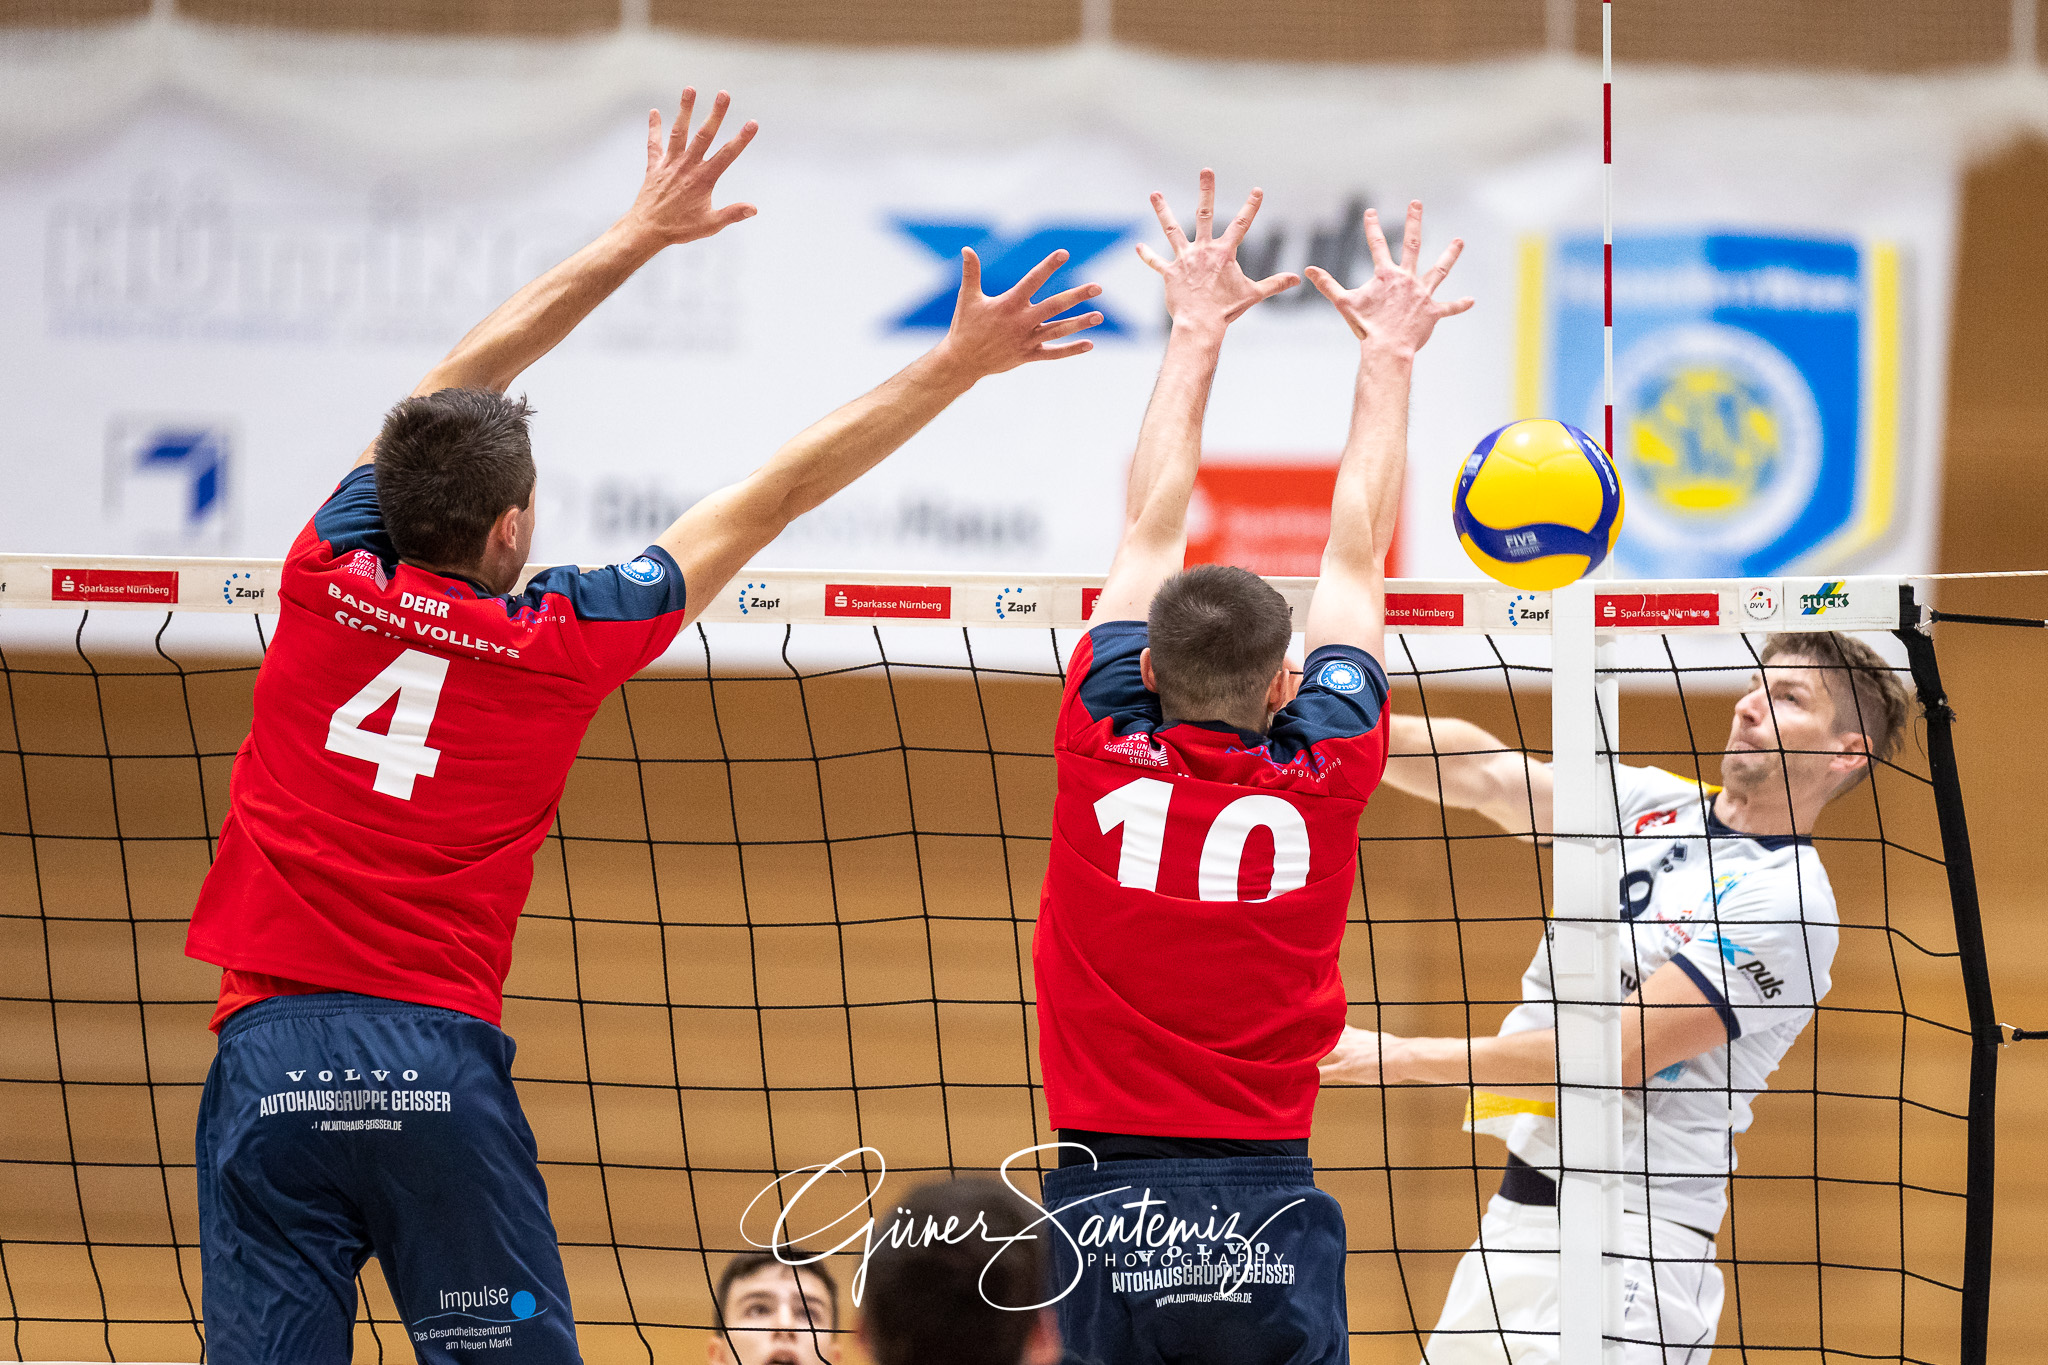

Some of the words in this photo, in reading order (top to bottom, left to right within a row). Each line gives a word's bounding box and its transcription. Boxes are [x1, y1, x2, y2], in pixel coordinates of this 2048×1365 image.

[1504, 531, 1538, 548] FIVB
[348, 567, 375, 580] STUDIO
[78, 583, 125, 595] Sparkasse
[126, 584, 170, 597] Nürnberg
[235, 587, 265, 599] Zapf
[399, 591, 450, 619] DERR
[751, 597, 780, 609] Zapf
[851, 598, 897, 611] Sparkasse
[899, 598, 942, 612] Nürnberg
[1007, 601, 1037, 613] Zapf
[1799, 592, 1850, 610] HUCK
[1385, 607, 1410, 618] kasse
[1412, 607, 1455, 619] Nürnberg
[1520, 609, 1550, 621] Zapf
[1620, 608, 1666, 619] Sparkasse
[327, 582, 406, 629] BADEN
[413, 621, 520, 659] VOLLEYS
[325, 647, 450, 802] 4
[1126, 733, 1149, 743] SSC
[1104, 744, 1151, 758] GESUNDHEIT
[1129, 756, 1158, 767] STUDIO
[1093, 776, 1311, 903] 10
[1737, 959, 1785, 1000] puls
[286, 1069, 418, 1082] VOLVO
[260, 1089, 388, 1117] AUTOHAUSGRUPPE
[391, 1090, 451, 1112] GEISSER
[1135, 1242, 1270, 1262] VOLVO
[1243, 1264, 1296, 1285] GEISSER
[439, 1286, 509, 1312] Impulse
[414, 1331, 428, 1342] Das
[429, 1325, 511, 1339] Gesundheitszentrum
[445, 1341, 459, 1350] am
[460, 1340, 487, 1350] Neuen
[489, 1337, 512, 1348] Markt
